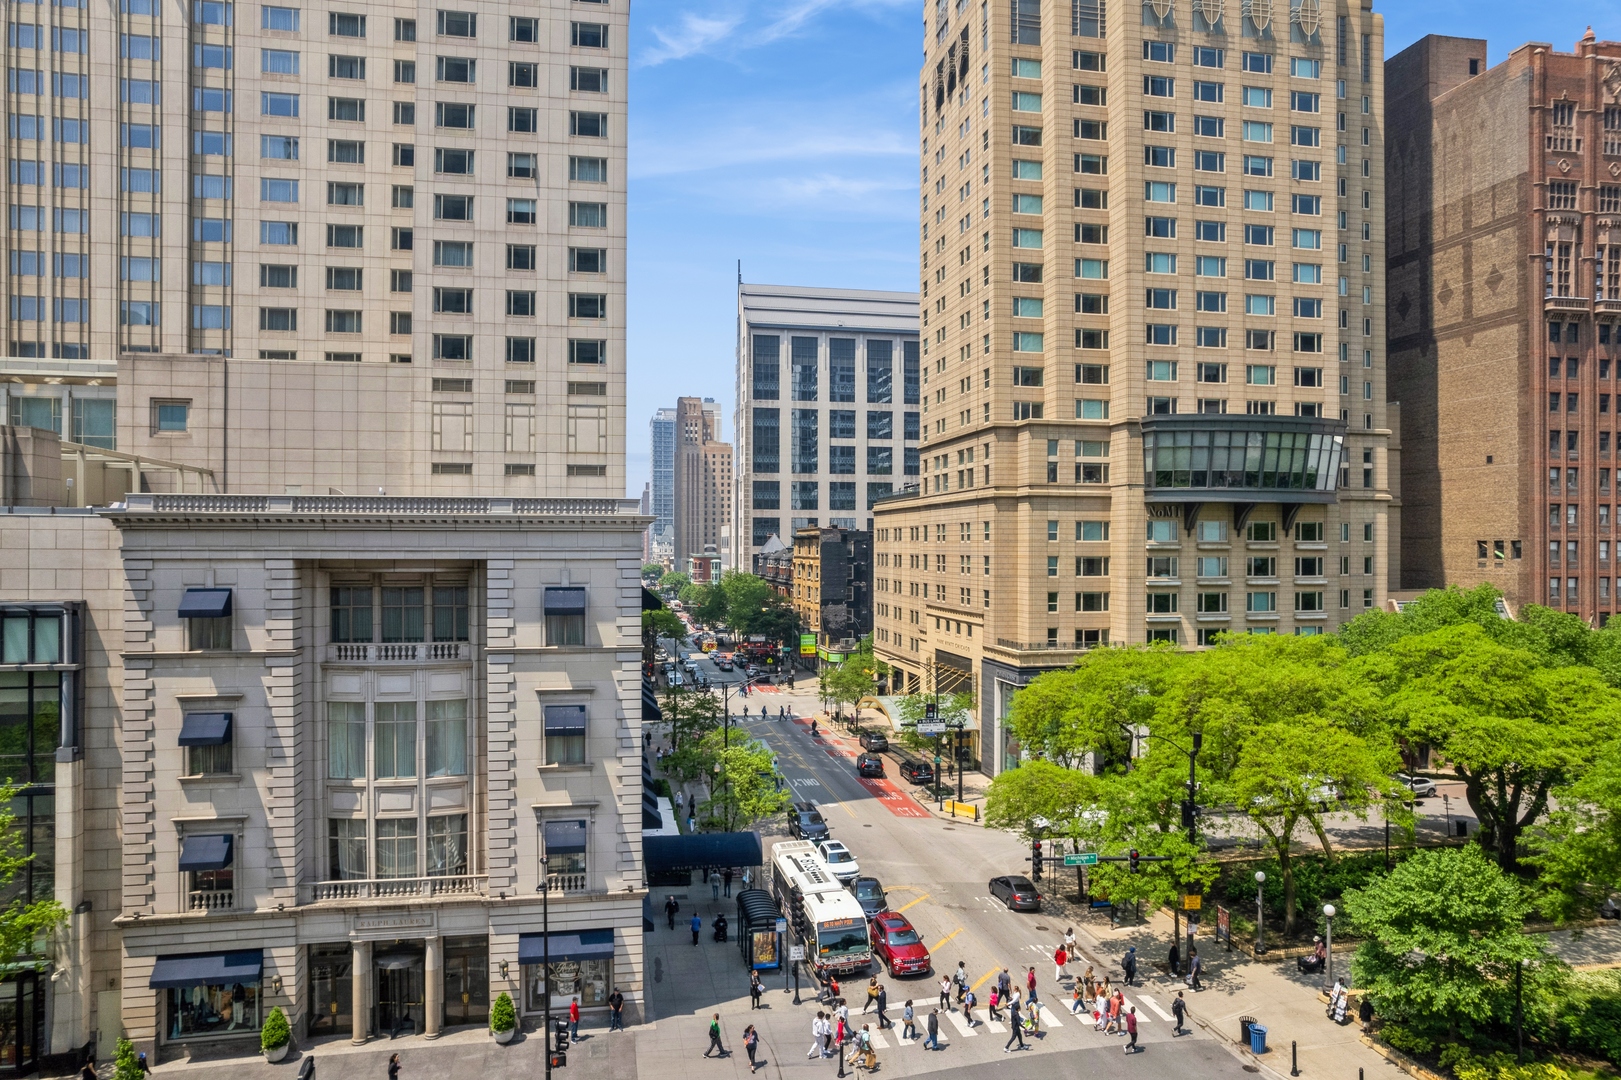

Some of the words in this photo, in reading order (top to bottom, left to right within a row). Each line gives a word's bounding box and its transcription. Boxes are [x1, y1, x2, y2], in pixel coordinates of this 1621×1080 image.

[954, 643, 970, 652] CHICAGO
[793, 778, 820, 787] ONLY
[862, 778, 888, 787] ONLY
[878, 792, 903, 800] BUS
[897, 807, 922, 816] CTA
[393, 918, 426, 926] LAUREN
